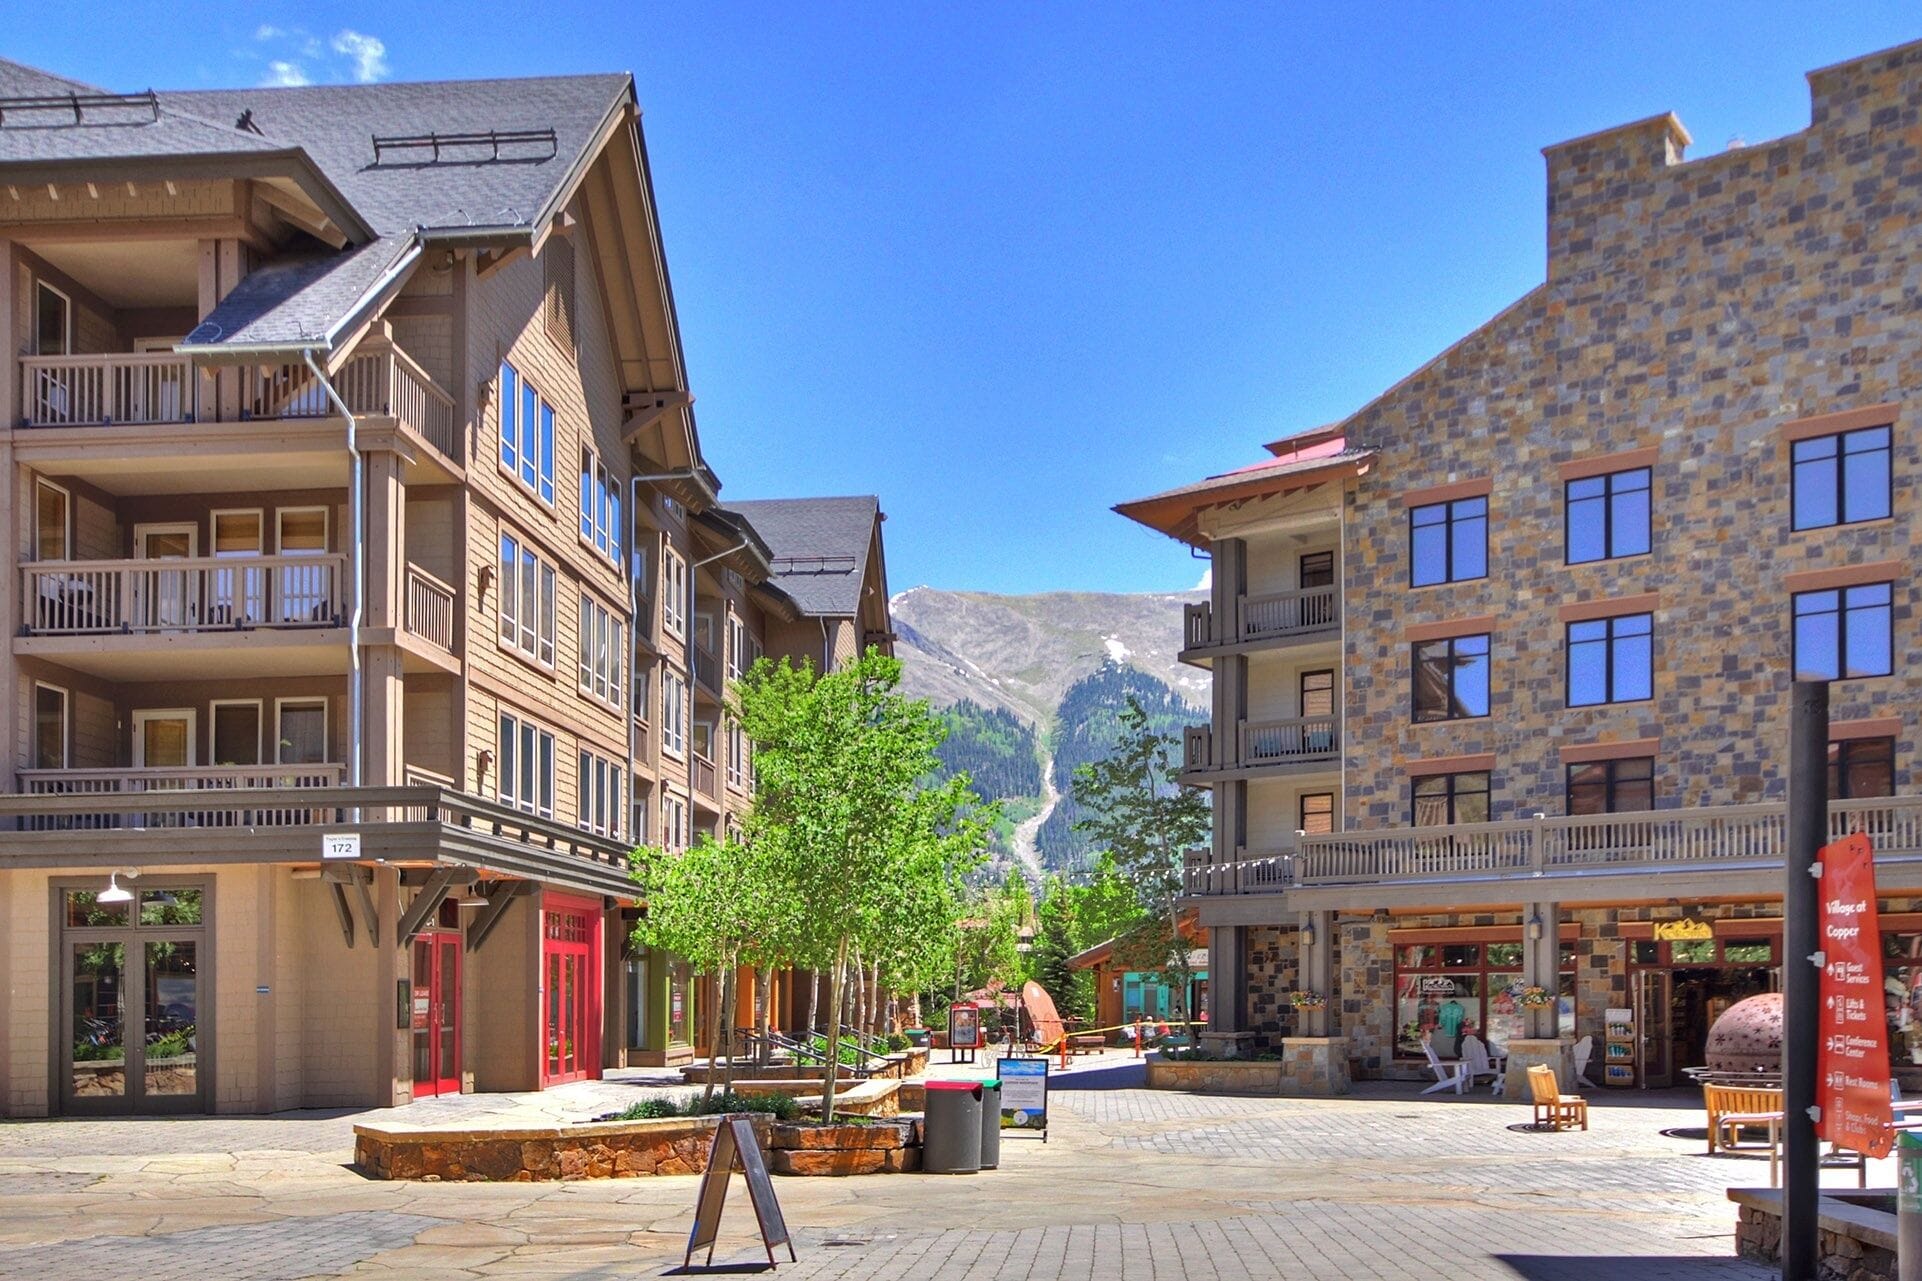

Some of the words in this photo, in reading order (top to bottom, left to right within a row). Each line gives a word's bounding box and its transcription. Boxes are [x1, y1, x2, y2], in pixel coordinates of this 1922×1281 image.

[332, 843, 352, 853] 172
[1826, 900, 1855, 915] Village
[1856, 900, 1867, 912] at
[1826, 924, 1859, 940] Copper
[1846, 962, 1863, 973] Guest
[1846, 973, 1870, 984] Services
[1845, 998, 1859, 1009] Lifts
[1859, 998, 1865, 1009] &
[1846, 1009, 1867, 1021] Tickets
[1845, 1035, 1878, 1048] Conference
[1845, 1046, 1865, 1058] Center
[1845, 1075, 1858, 1087] Rest
[1858, 1077, 1878, 1090] Rooms
